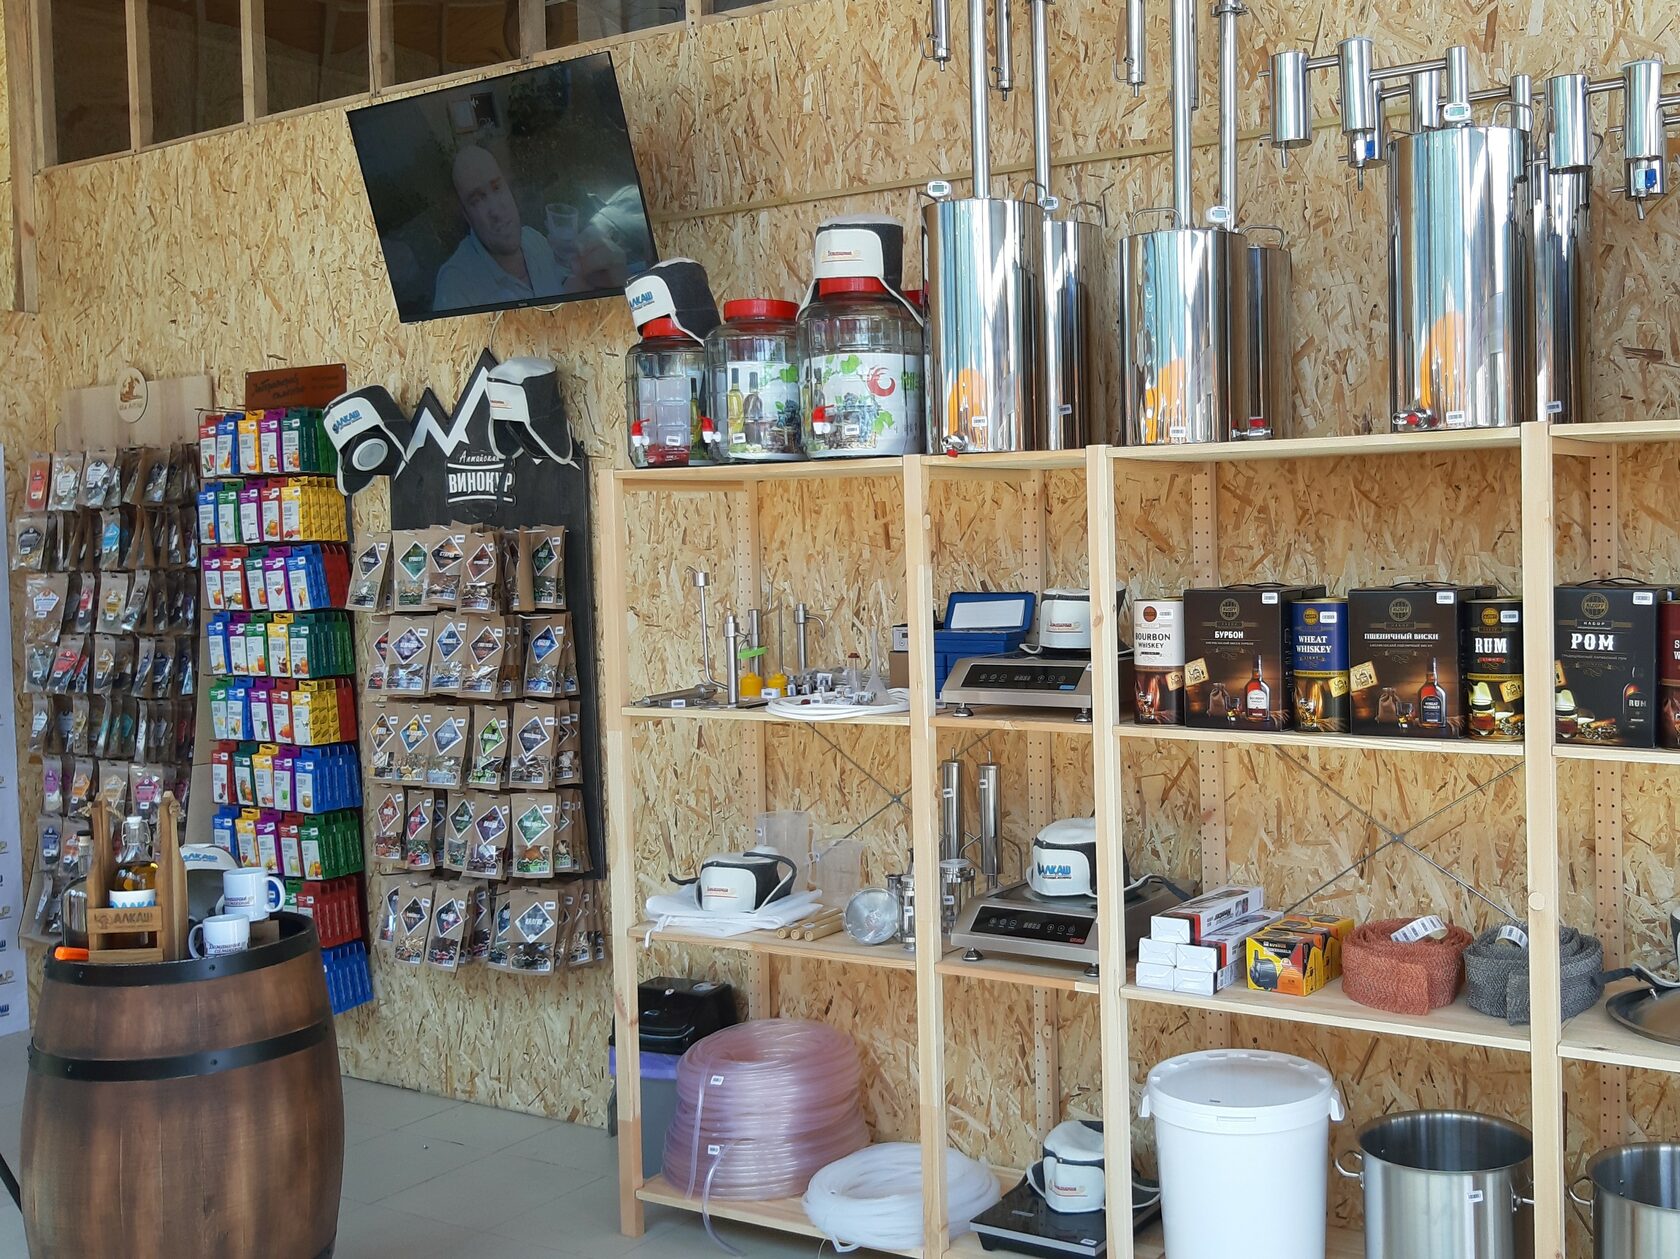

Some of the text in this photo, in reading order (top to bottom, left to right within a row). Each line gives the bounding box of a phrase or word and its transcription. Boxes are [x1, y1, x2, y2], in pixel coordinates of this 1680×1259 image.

[1135, 632, 1171, 641] BOURBON
[1214, 631, 1244, 639] БУРБОН
[1364, 632, 1412, 640] ПШЕНИЧНЫЙ
[1298, 635, 1327, 644] WHEAT
[1571, 633, 1614, 651] РОМ
[1296, 645, 1332, 653] WHISKEY
[1474, 637, 1508, 654] RUM
[1629, 699, 1647, 707] RUM
